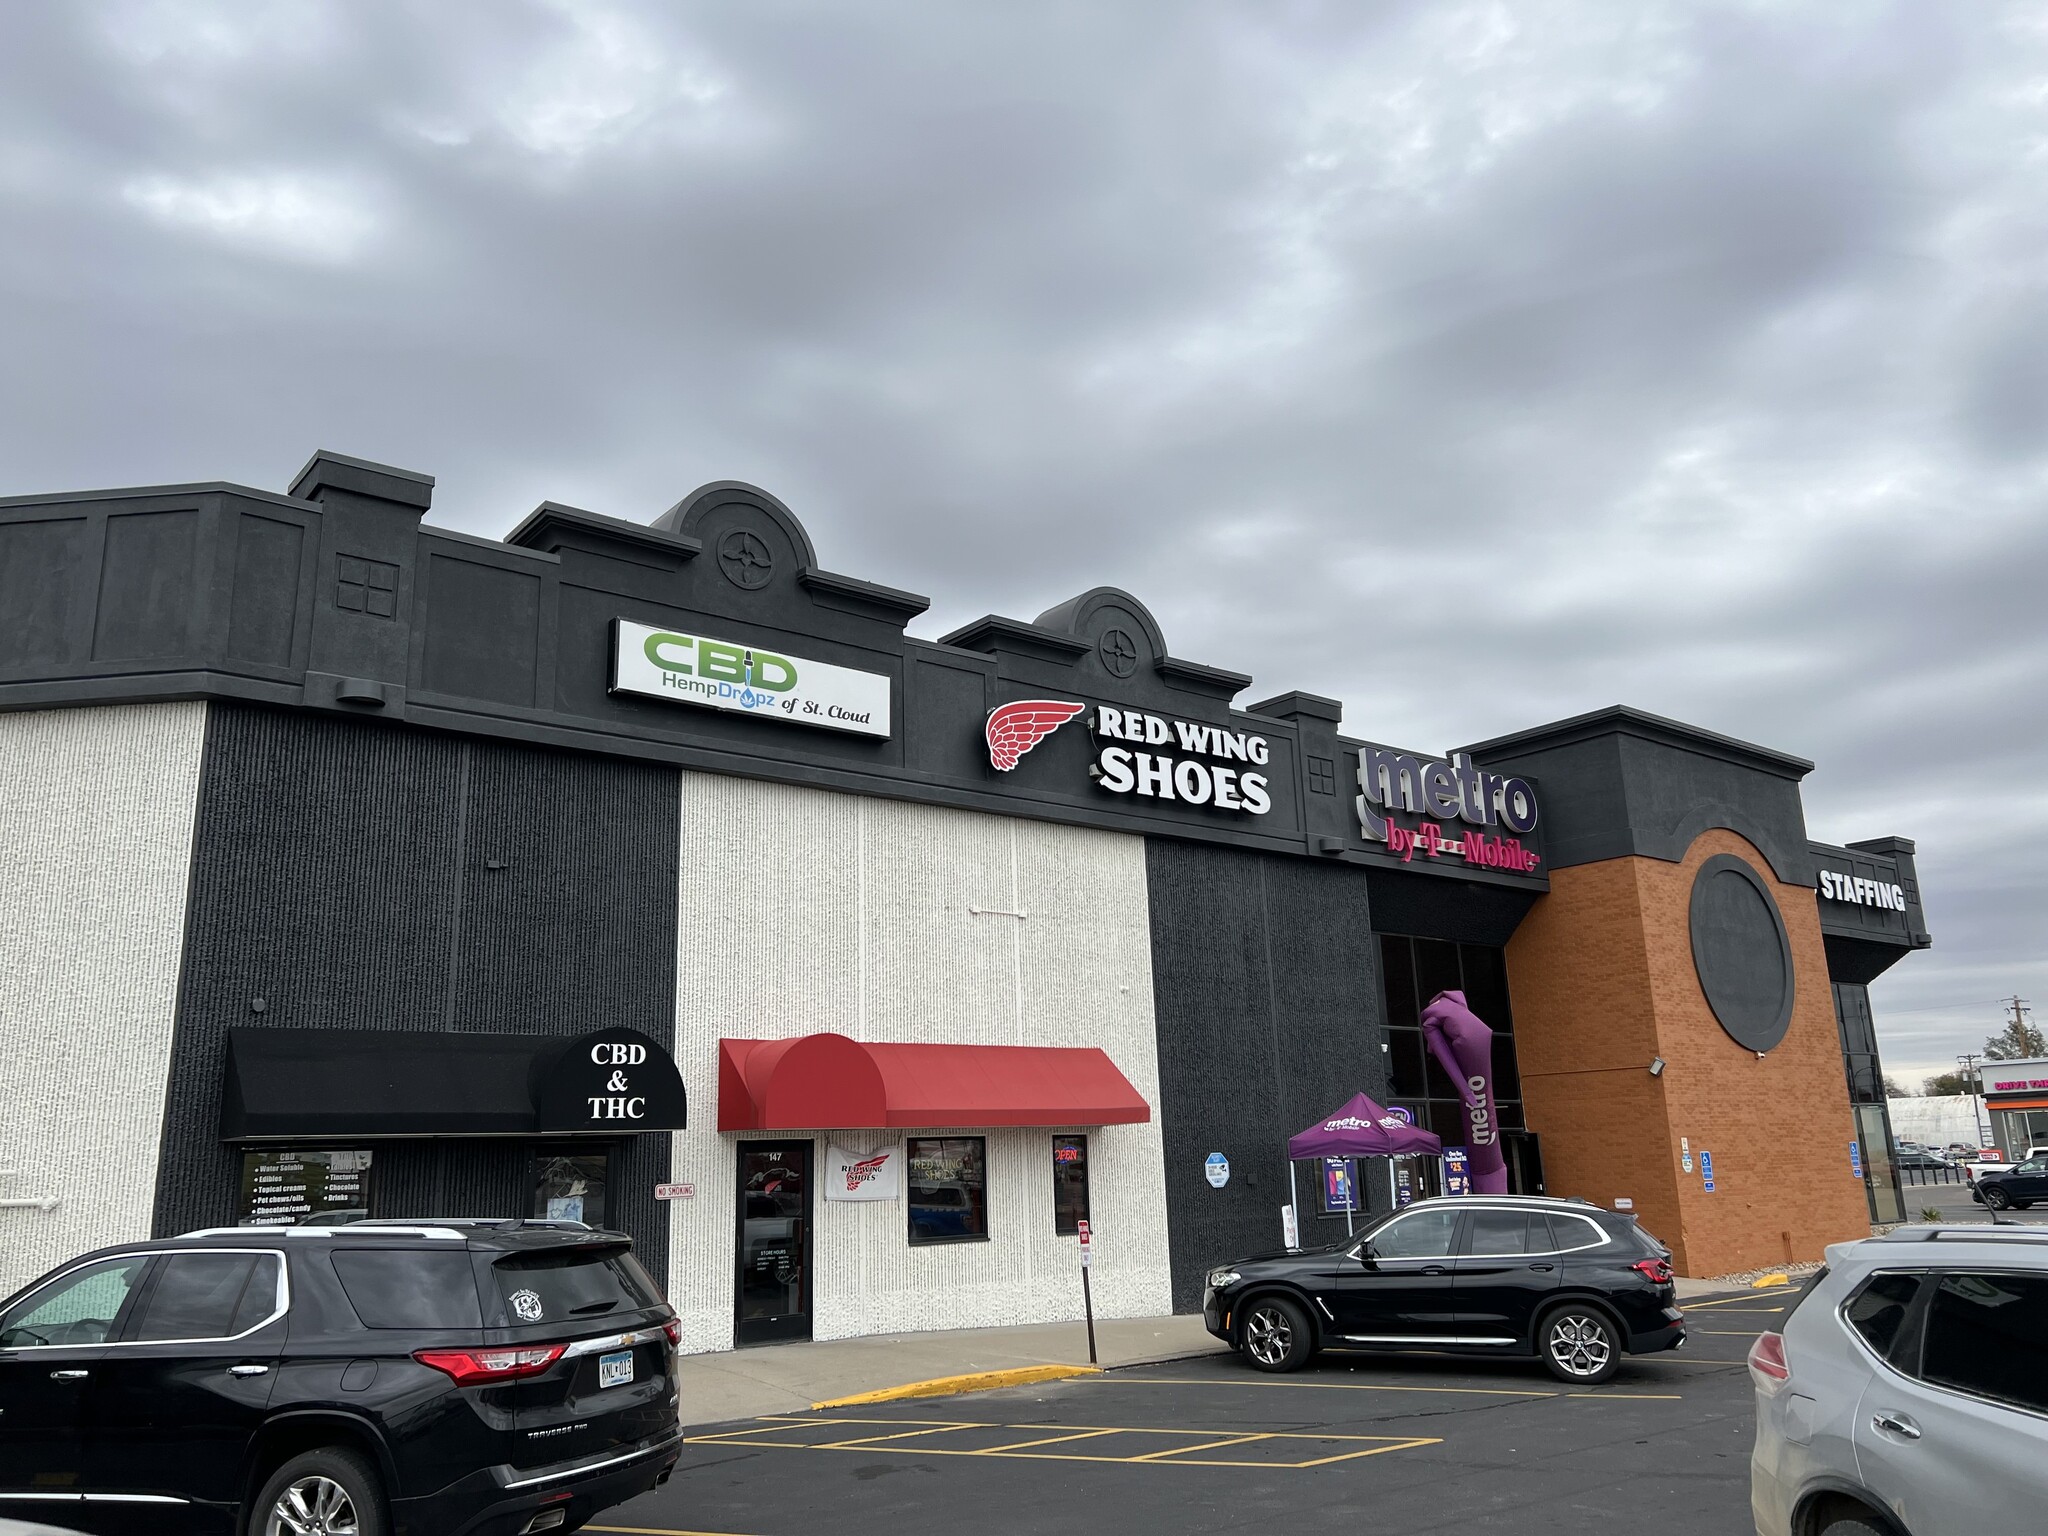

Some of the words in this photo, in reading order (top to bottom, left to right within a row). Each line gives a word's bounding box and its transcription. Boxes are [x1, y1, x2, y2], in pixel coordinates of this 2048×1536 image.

[644, 633, 798, 692] CBD
[662, 672, 775, 709] HempDropz
[781, 698, 799, 714] of
[802, 701, 823, 716] St.
[827, 705, 870, 724] Cloud
[1098, 705, 1169, 745] RED
[1174, 720, 1269, 765] WING
[1099, 746, 1271, 814] SHOES
[1357, 747, 1538, 833] metro
[1386, 816, 1417, 863] by
[1820, 869, 1906, 911] STAFFING
[591, 1043, 646, 1065] CBD
[607, 1070, 628, 1091] &
[1995, 1082, 2027, 1090] DRIVE
[588, 1097, 645, 1119] THC
[1327, 1117, 1371, 1128] metro
[769, 1153, 782, 1162] 147
[914, 1160, 933, 1170] RED
[925, 1169, 956, 1180] SHOES
[658, 1187, 666, 1196] NO
[668, 1185, 693, 1196] SMOKING
[257, 1205, 311, 1214] Chocolate/candy
[256, 1217, 295, 1225] Smokeables
[528, 1425, 572, 1440] TRAVERSE
